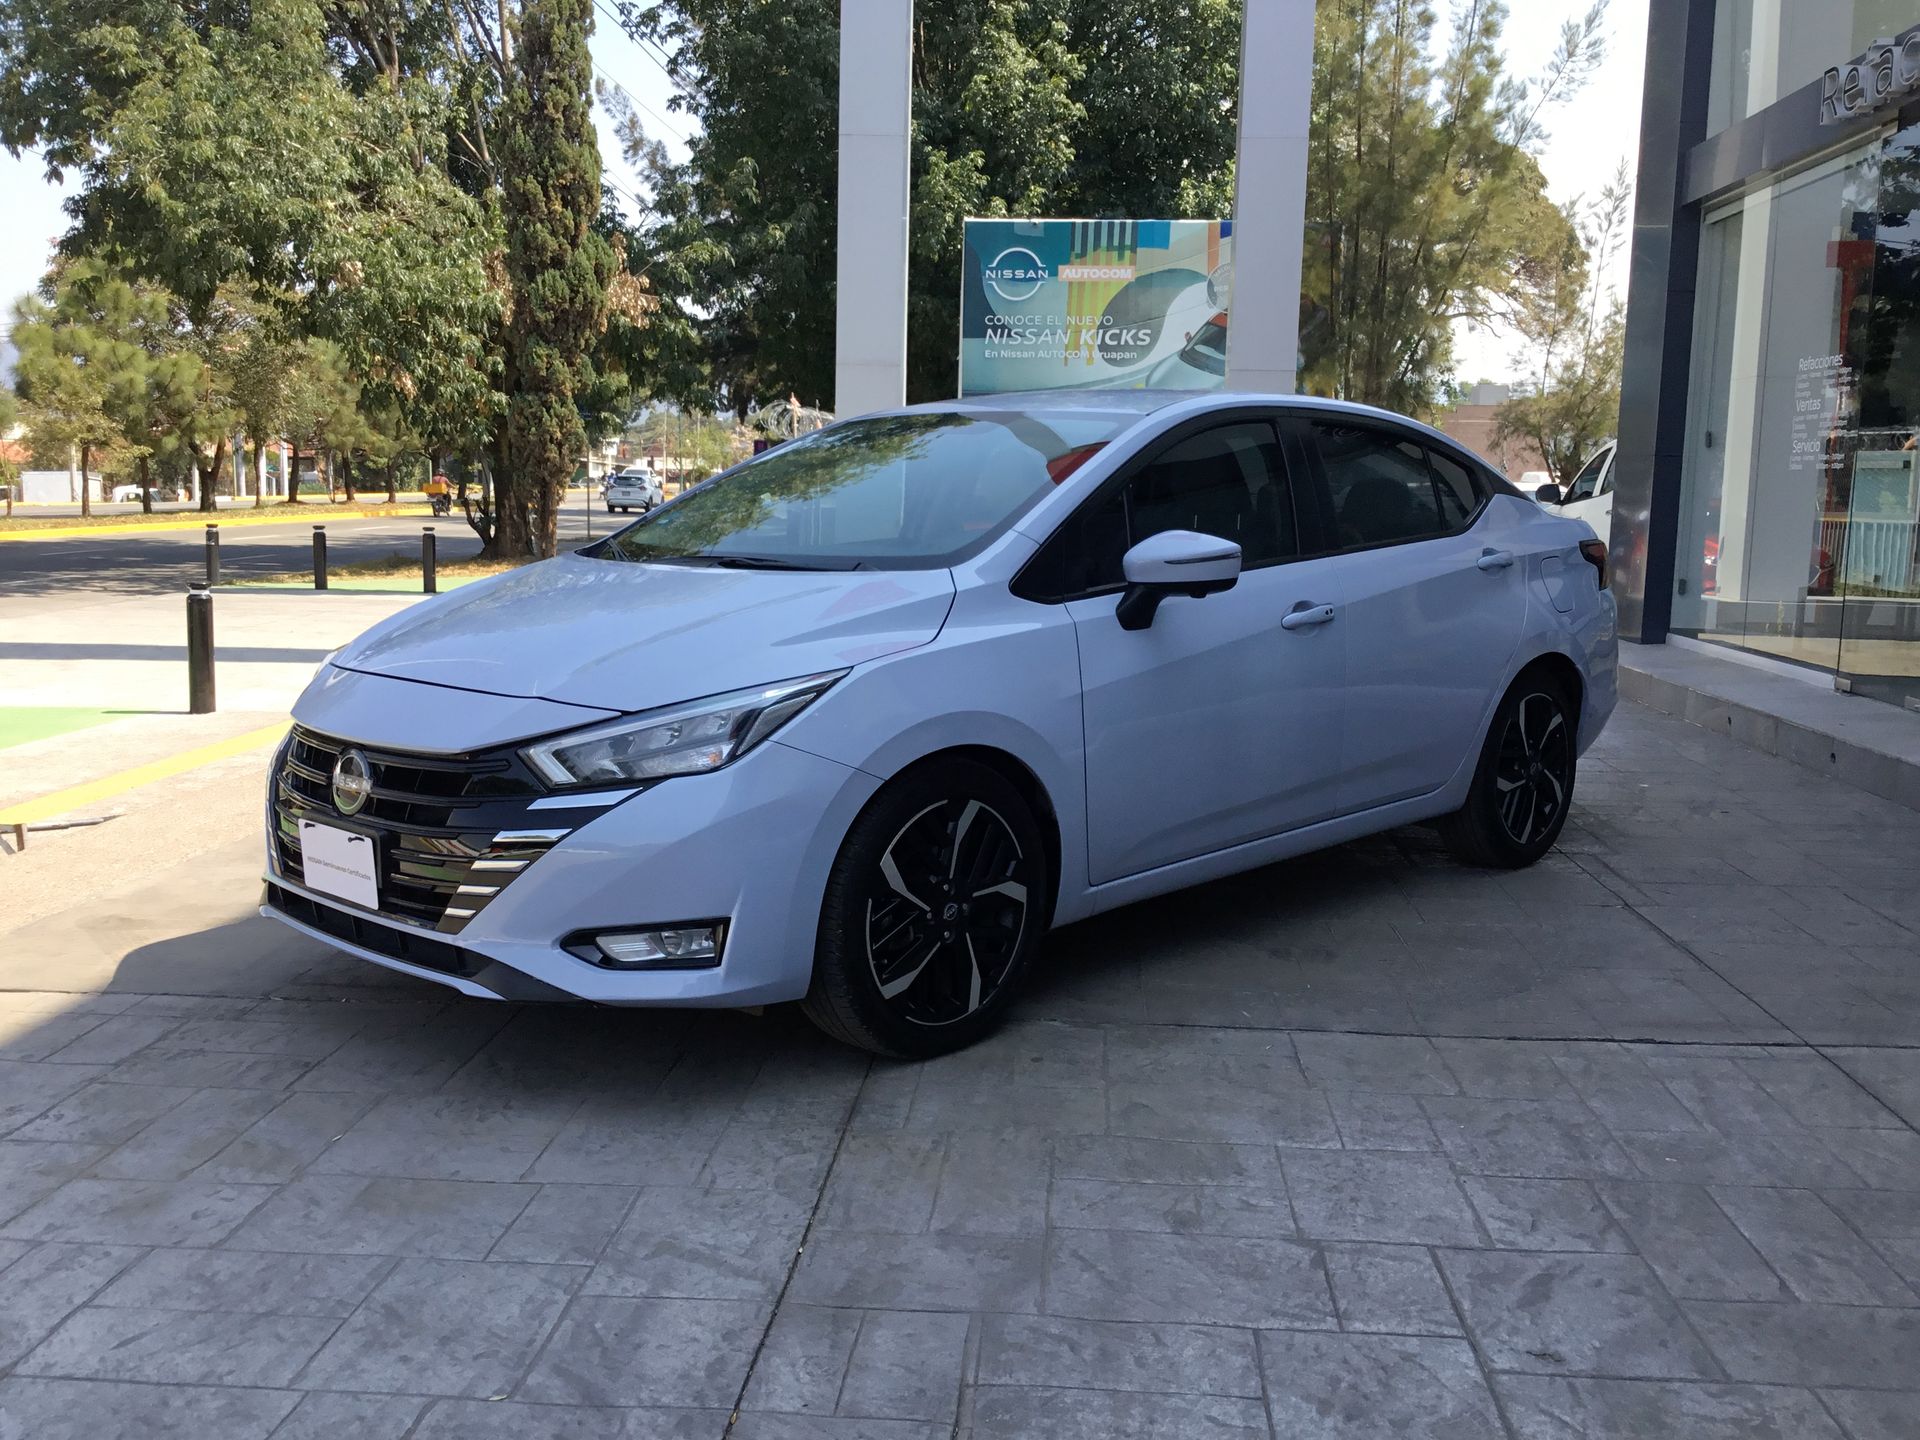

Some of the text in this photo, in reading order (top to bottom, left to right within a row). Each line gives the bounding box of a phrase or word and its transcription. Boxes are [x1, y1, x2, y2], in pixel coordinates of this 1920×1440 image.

[985, 269, 1049, 279] NISSAN
[1062, 268, 1132, 280] AUTOCOM
[984, 315, 1113, 326] CONOCE EL NUEVO
[984, 328, 1152, 346] NISSAN KICKS
[984, 350, 1138, 361] En Nissan AUTOCOM Uruapan
[1798, 353, 1844, 371] Refacciones
[1796, 399, 1821, 412] Ventas
[1792, 439, 1821, 453] Servicio
